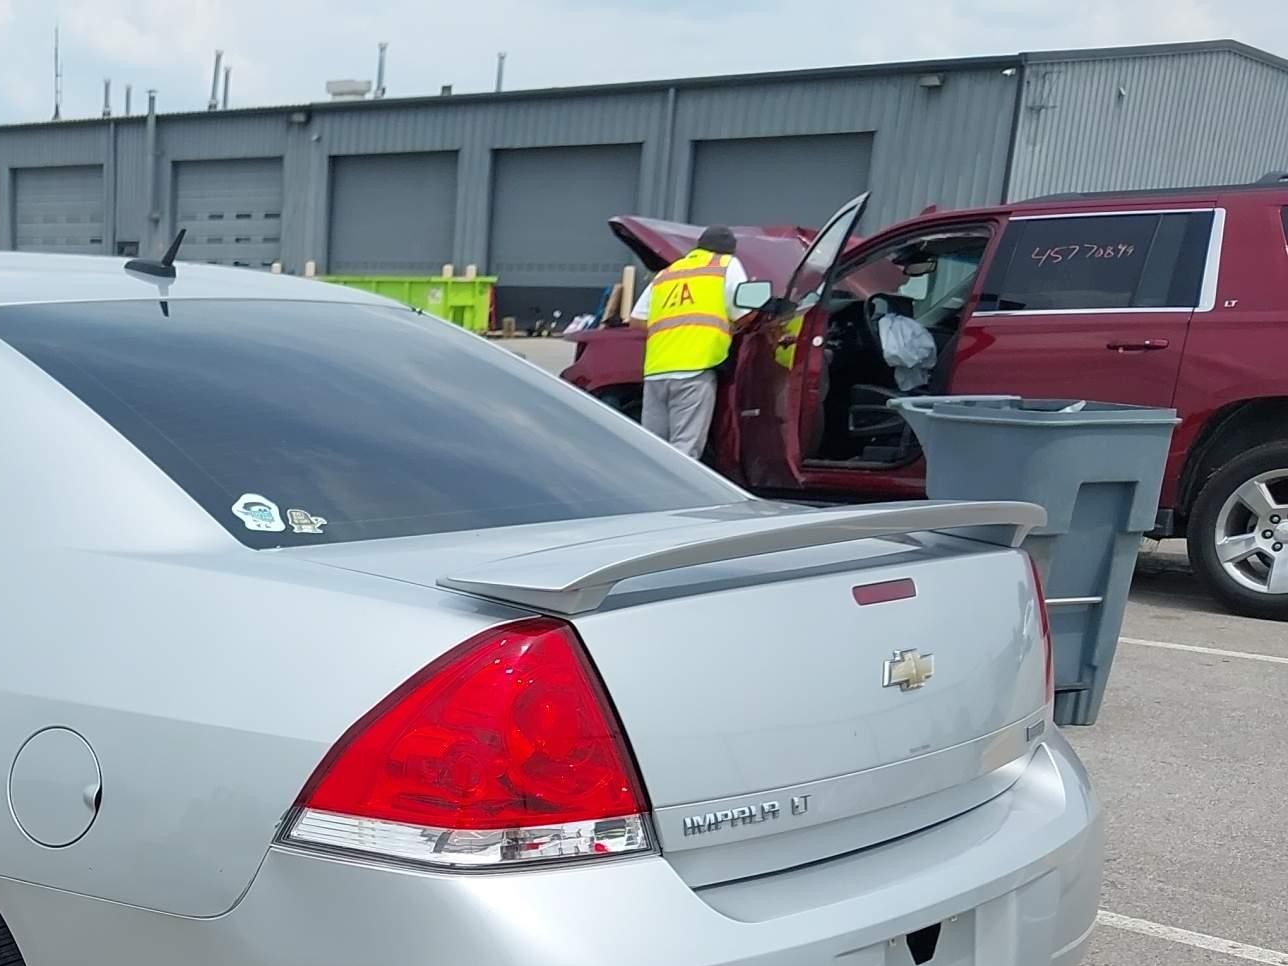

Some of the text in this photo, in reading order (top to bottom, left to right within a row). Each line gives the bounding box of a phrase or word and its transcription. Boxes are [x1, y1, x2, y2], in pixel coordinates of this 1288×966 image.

[1224, 299, 1238, 307] LT
[683, 795, 811, 836] IMPALA LT
